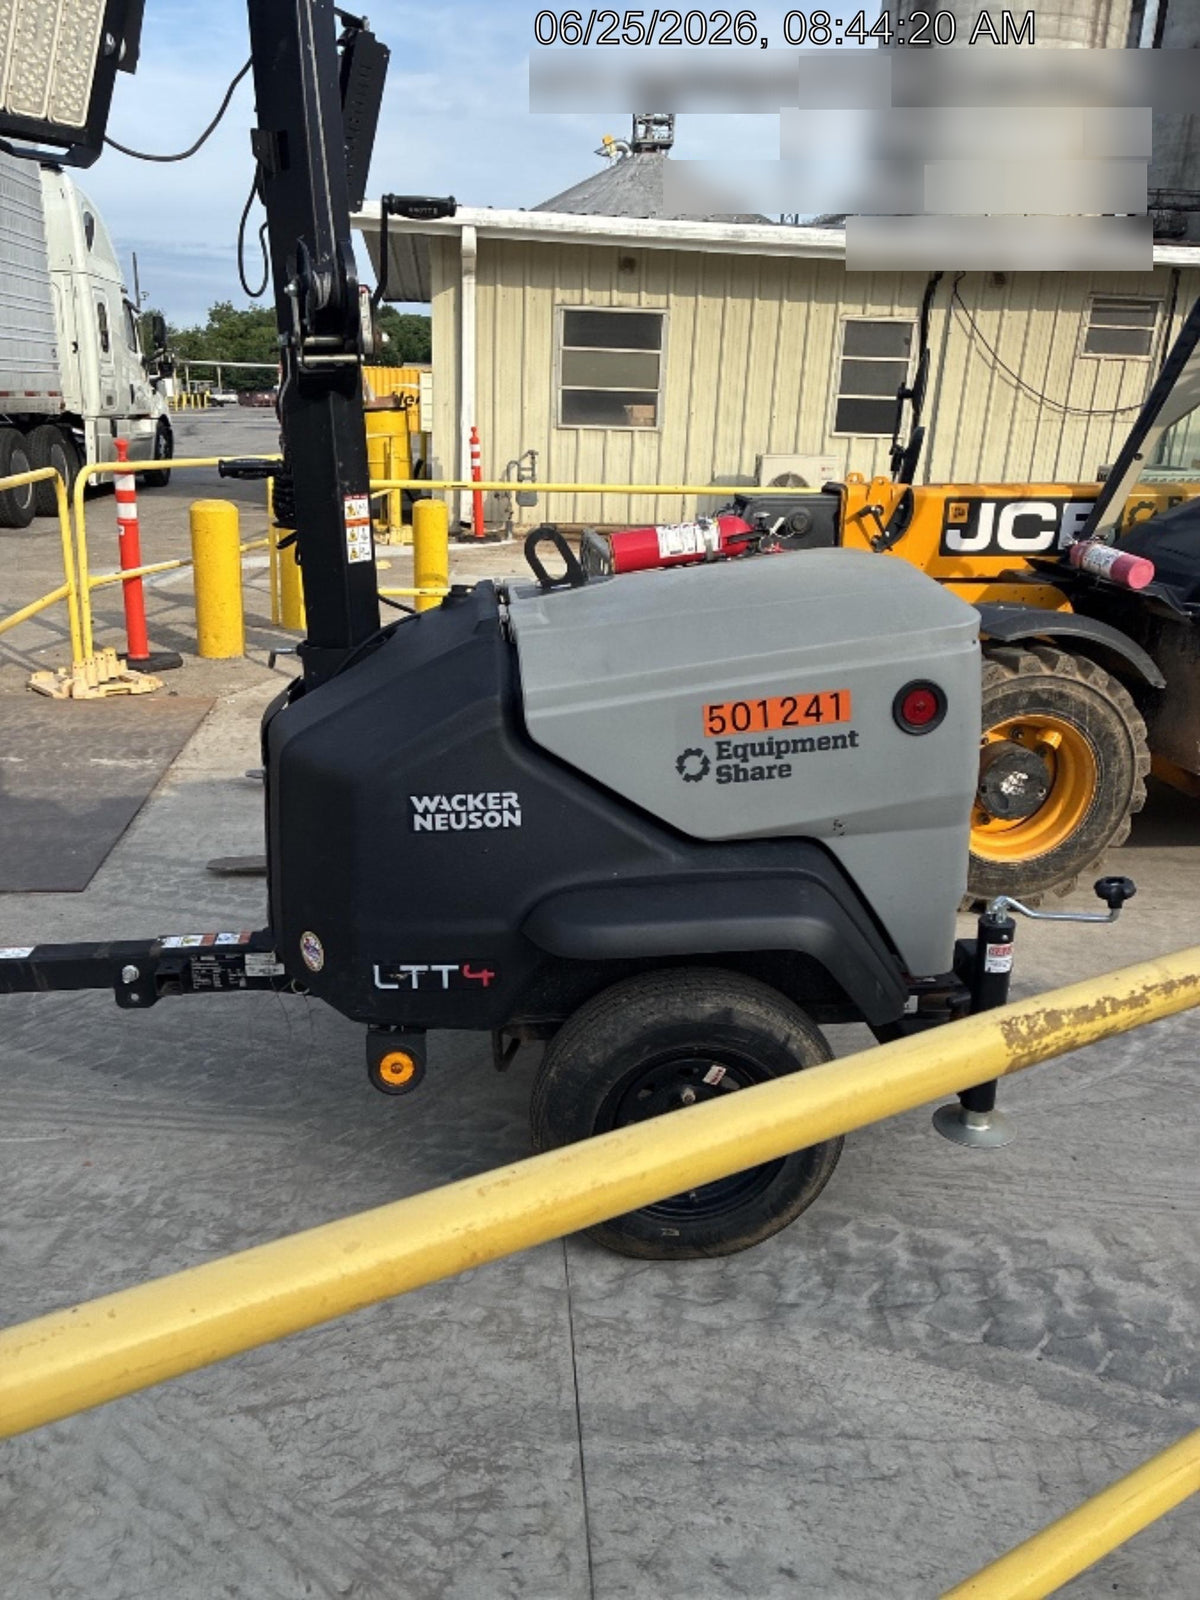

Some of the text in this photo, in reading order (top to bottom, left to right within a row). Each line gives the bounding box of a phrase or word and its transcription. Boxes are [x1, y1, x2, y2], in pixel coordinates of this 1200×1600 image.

[708, 692, 841, 735] 501241
[715, 730, 859, 763] Equipment
[715, 763, 792, 784] Share
[410, 791, 521, 813] WACKER
[413, 809, 521, 831] NEUSON
[373, 964, 495, 989] LTT4
